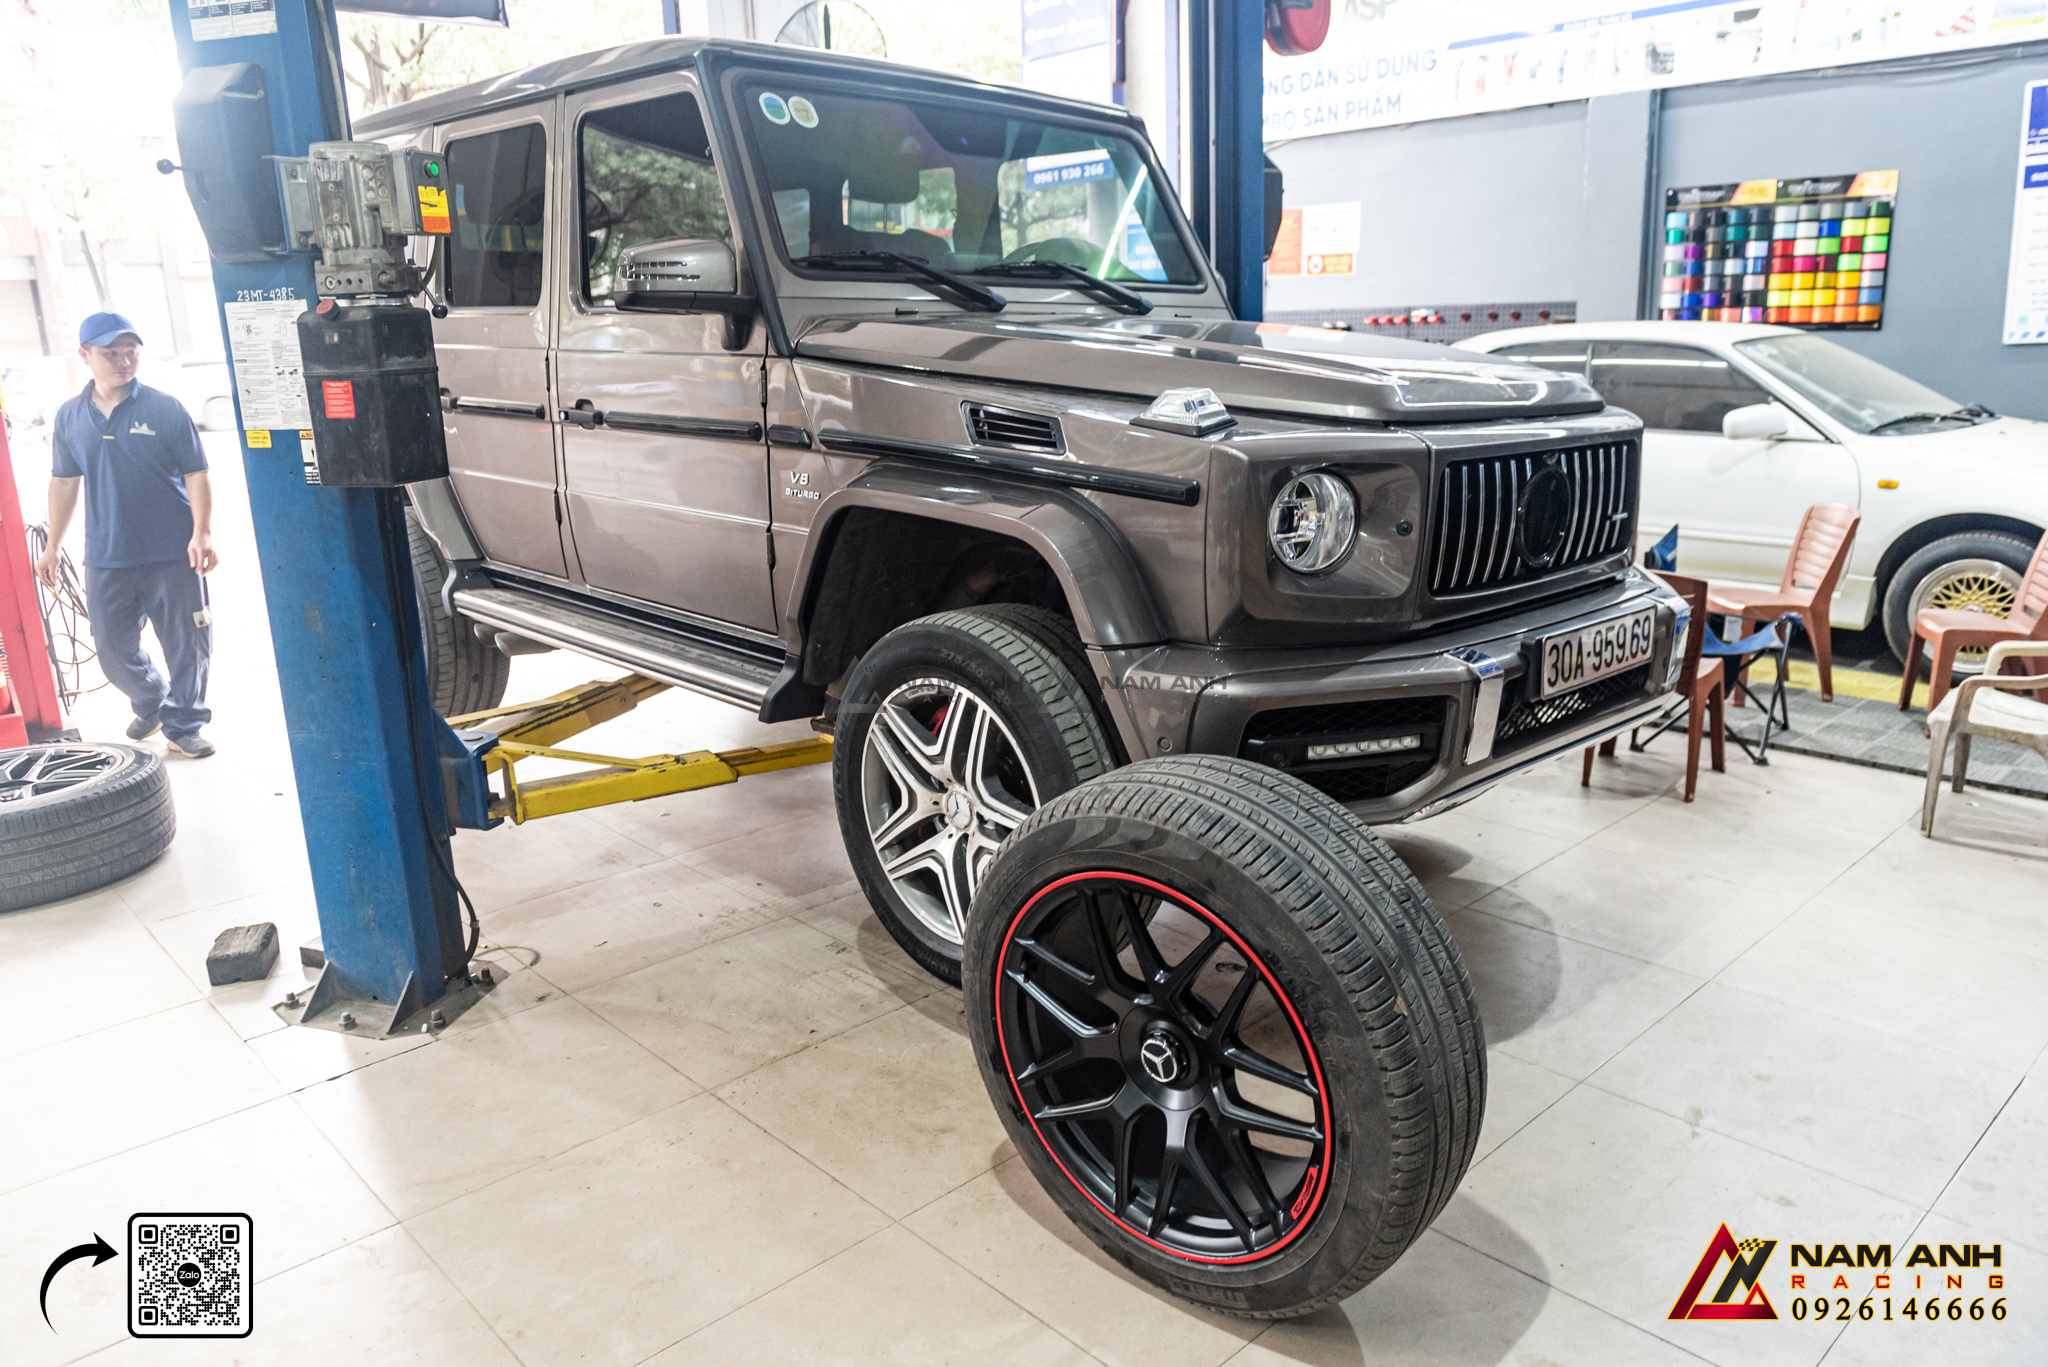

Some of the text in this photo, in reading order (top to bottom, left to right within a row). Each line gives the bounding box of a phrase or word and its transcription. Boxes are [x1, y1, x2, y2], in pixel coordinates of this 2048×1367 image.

[1377, 50, 1437, 84] DỤNG
[1033, 163, 1104, 184] 0961 930 266
[237, 287, 295, 302] 23MT-4385
[790, 471, 809, 485] V8
[785, 487, 820, 500] BITURBO
